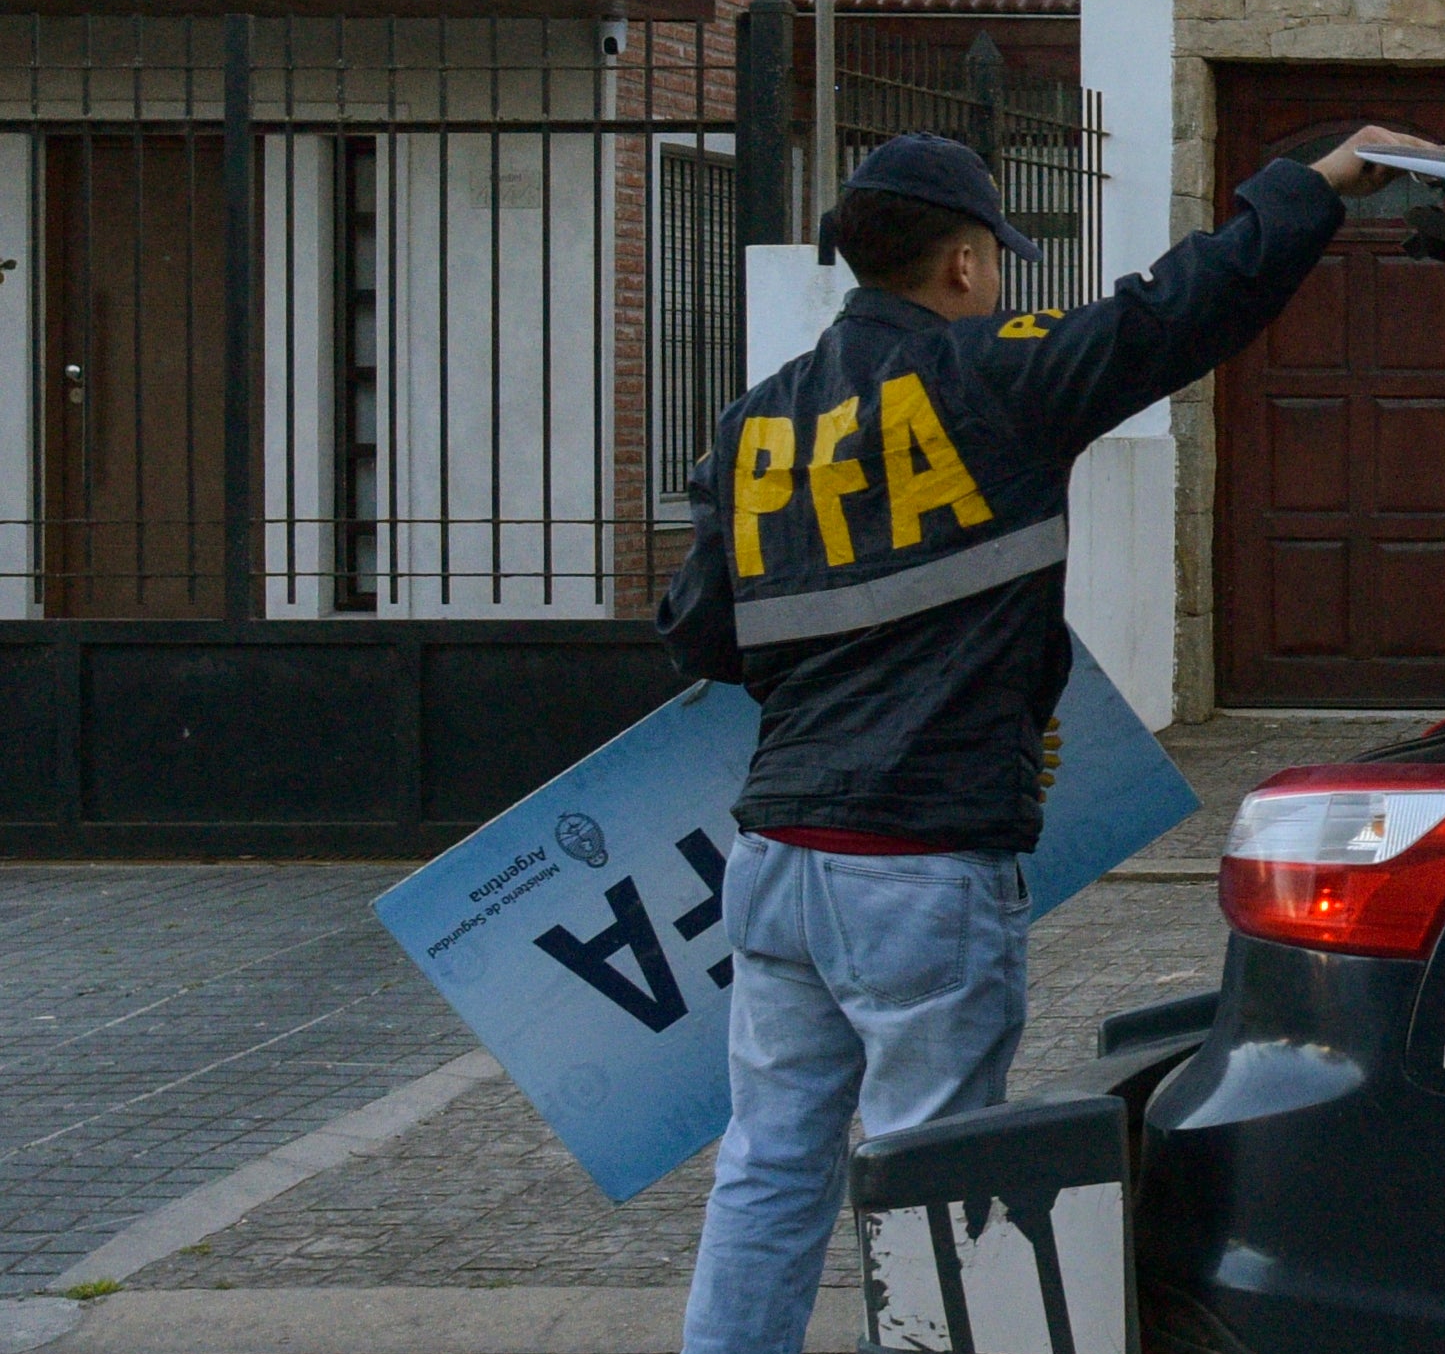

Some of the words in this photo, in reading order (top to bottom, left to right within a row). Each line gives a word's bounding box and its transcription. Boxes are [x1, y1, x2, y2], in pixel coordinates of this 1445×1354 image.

[733, 372, 993, 577] PFA
[469, 845, 547, 903] Argentina
[500, 862, 560, 906] Ministerio
[486, 904, 501, 918] de
[427, 914, 487, 959] Seguridad
